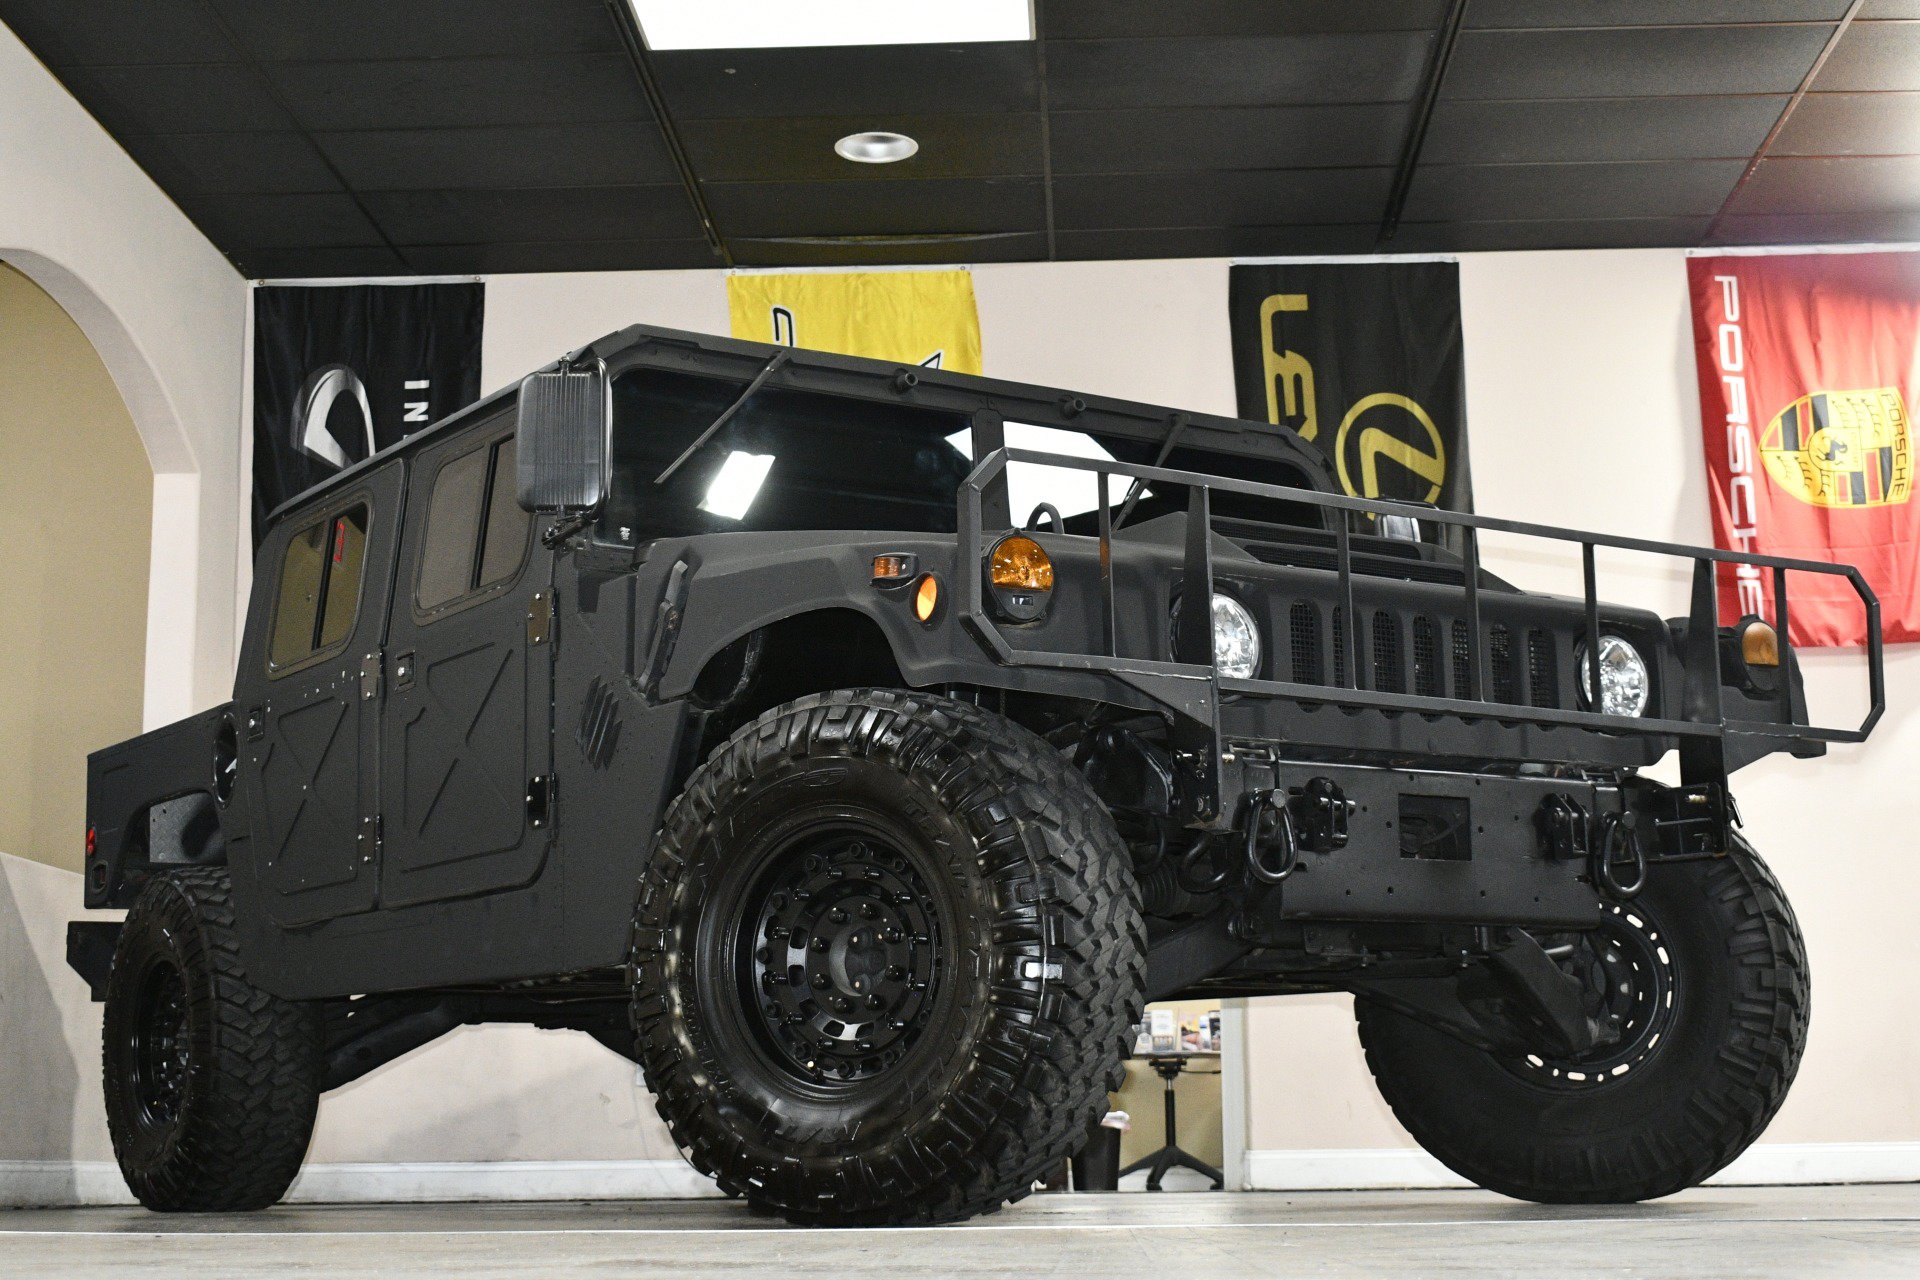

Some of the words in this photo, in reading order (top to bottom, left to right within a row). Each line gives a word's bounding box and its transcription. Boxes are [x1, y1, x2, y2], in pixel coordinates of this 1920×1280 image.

[403, 379, 430, 439] IN
[1260, 293, 1318, 442] LE
[1714, 274, 1766, 619] PORSCHE
[1881, 393, 1907, 497] PORSCHE
